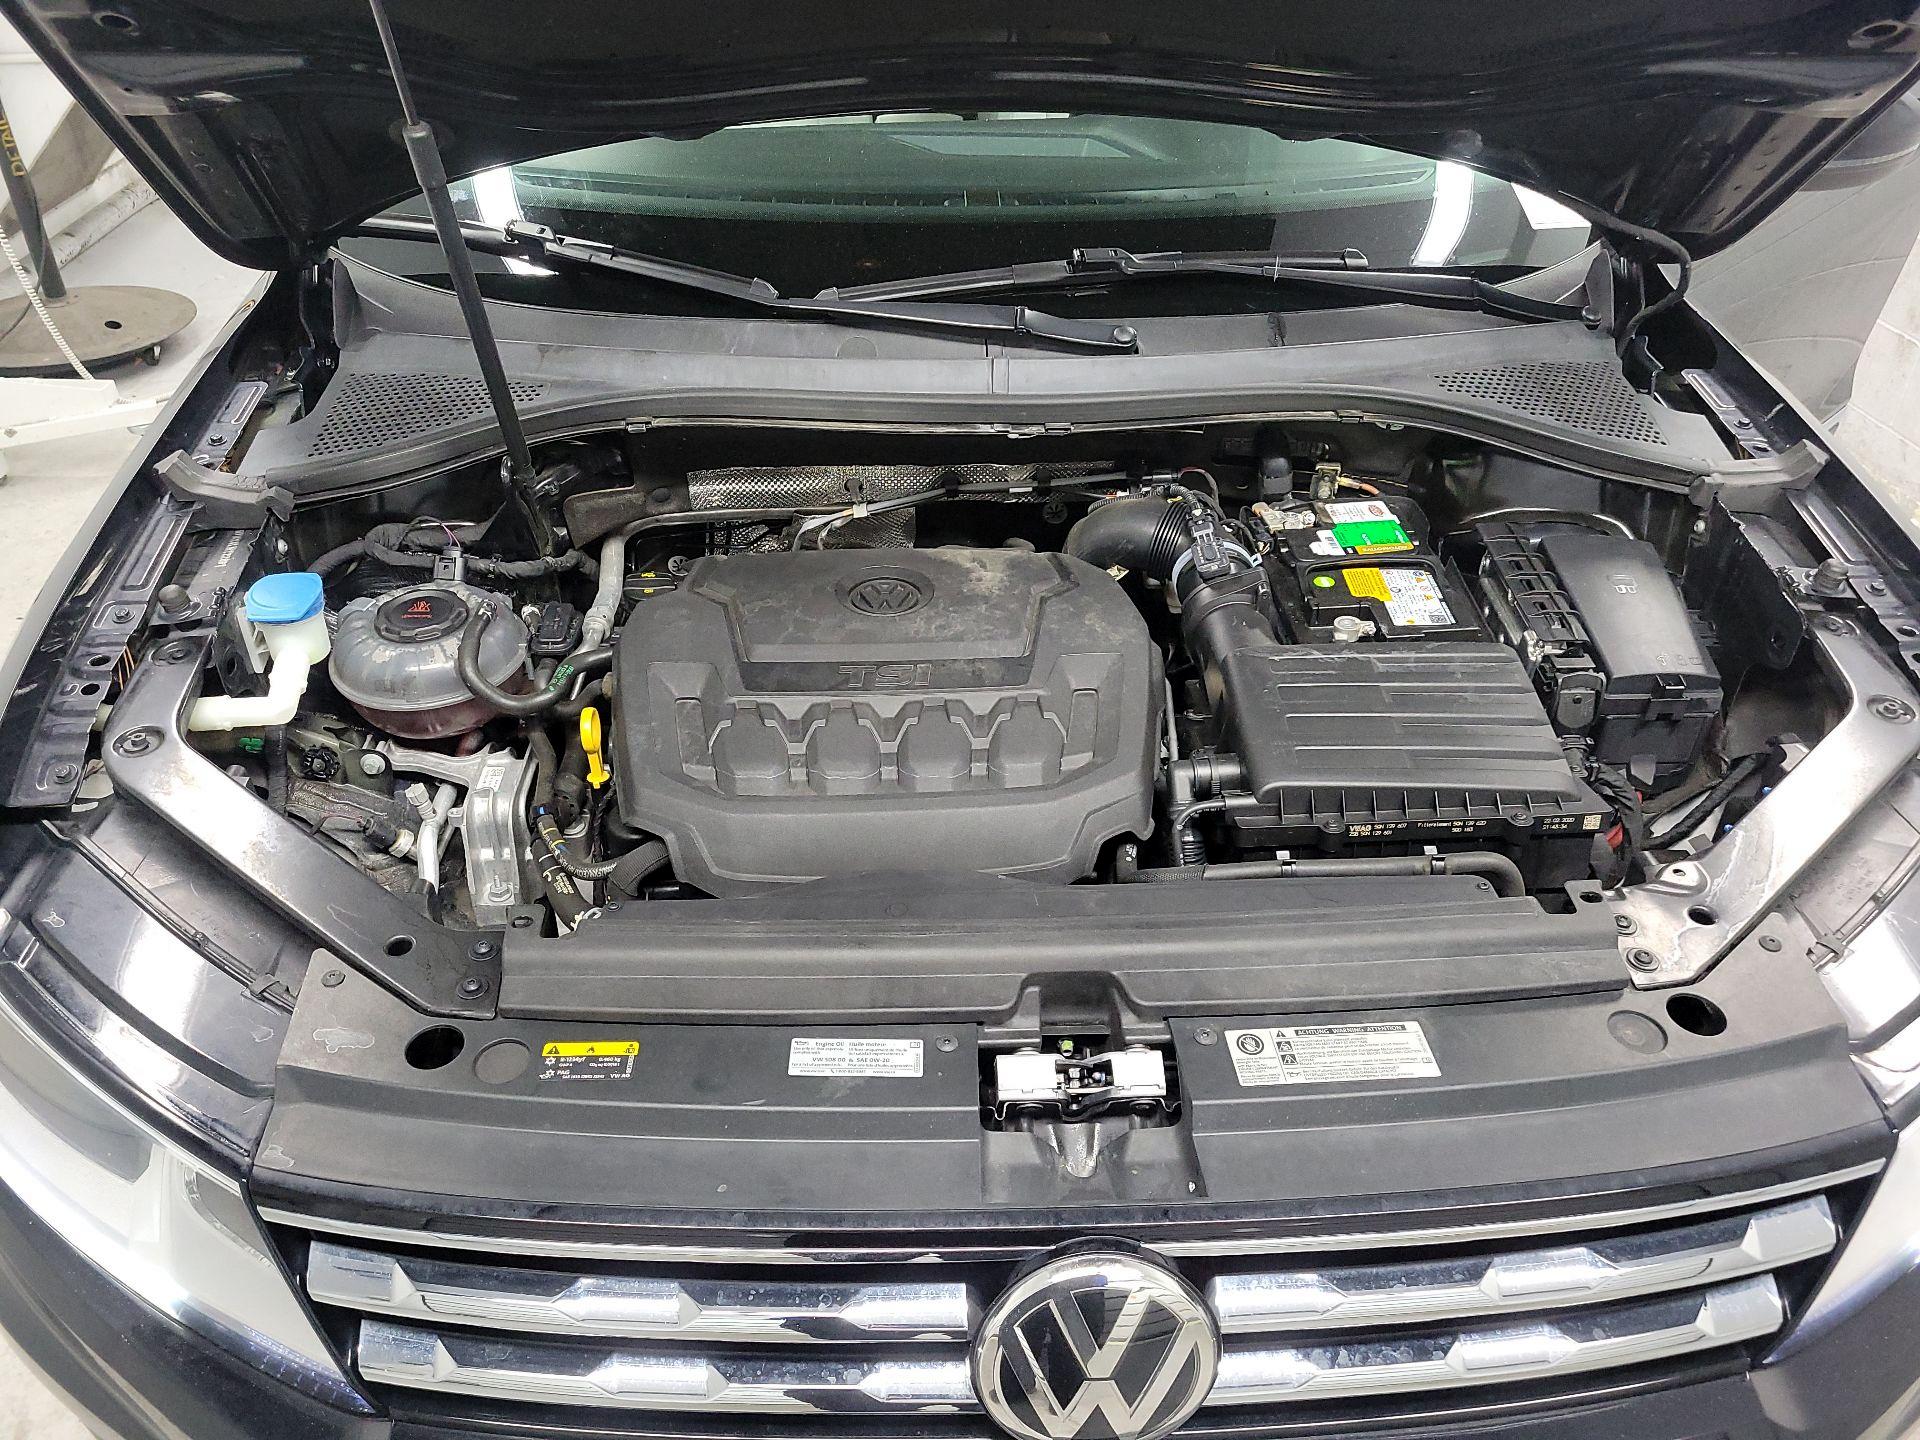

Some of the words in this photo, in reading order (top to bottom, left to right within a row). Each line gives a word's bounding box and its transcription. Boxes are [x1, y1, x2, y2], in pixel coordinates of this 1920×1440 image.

[839, 664, 932, 687] TSI
[1297, 1028, 1330, 1036] ACHTUNG
[1332, 1026, 1365, 1034] WARNING
[985, 1268, 1213, 1440] VW
